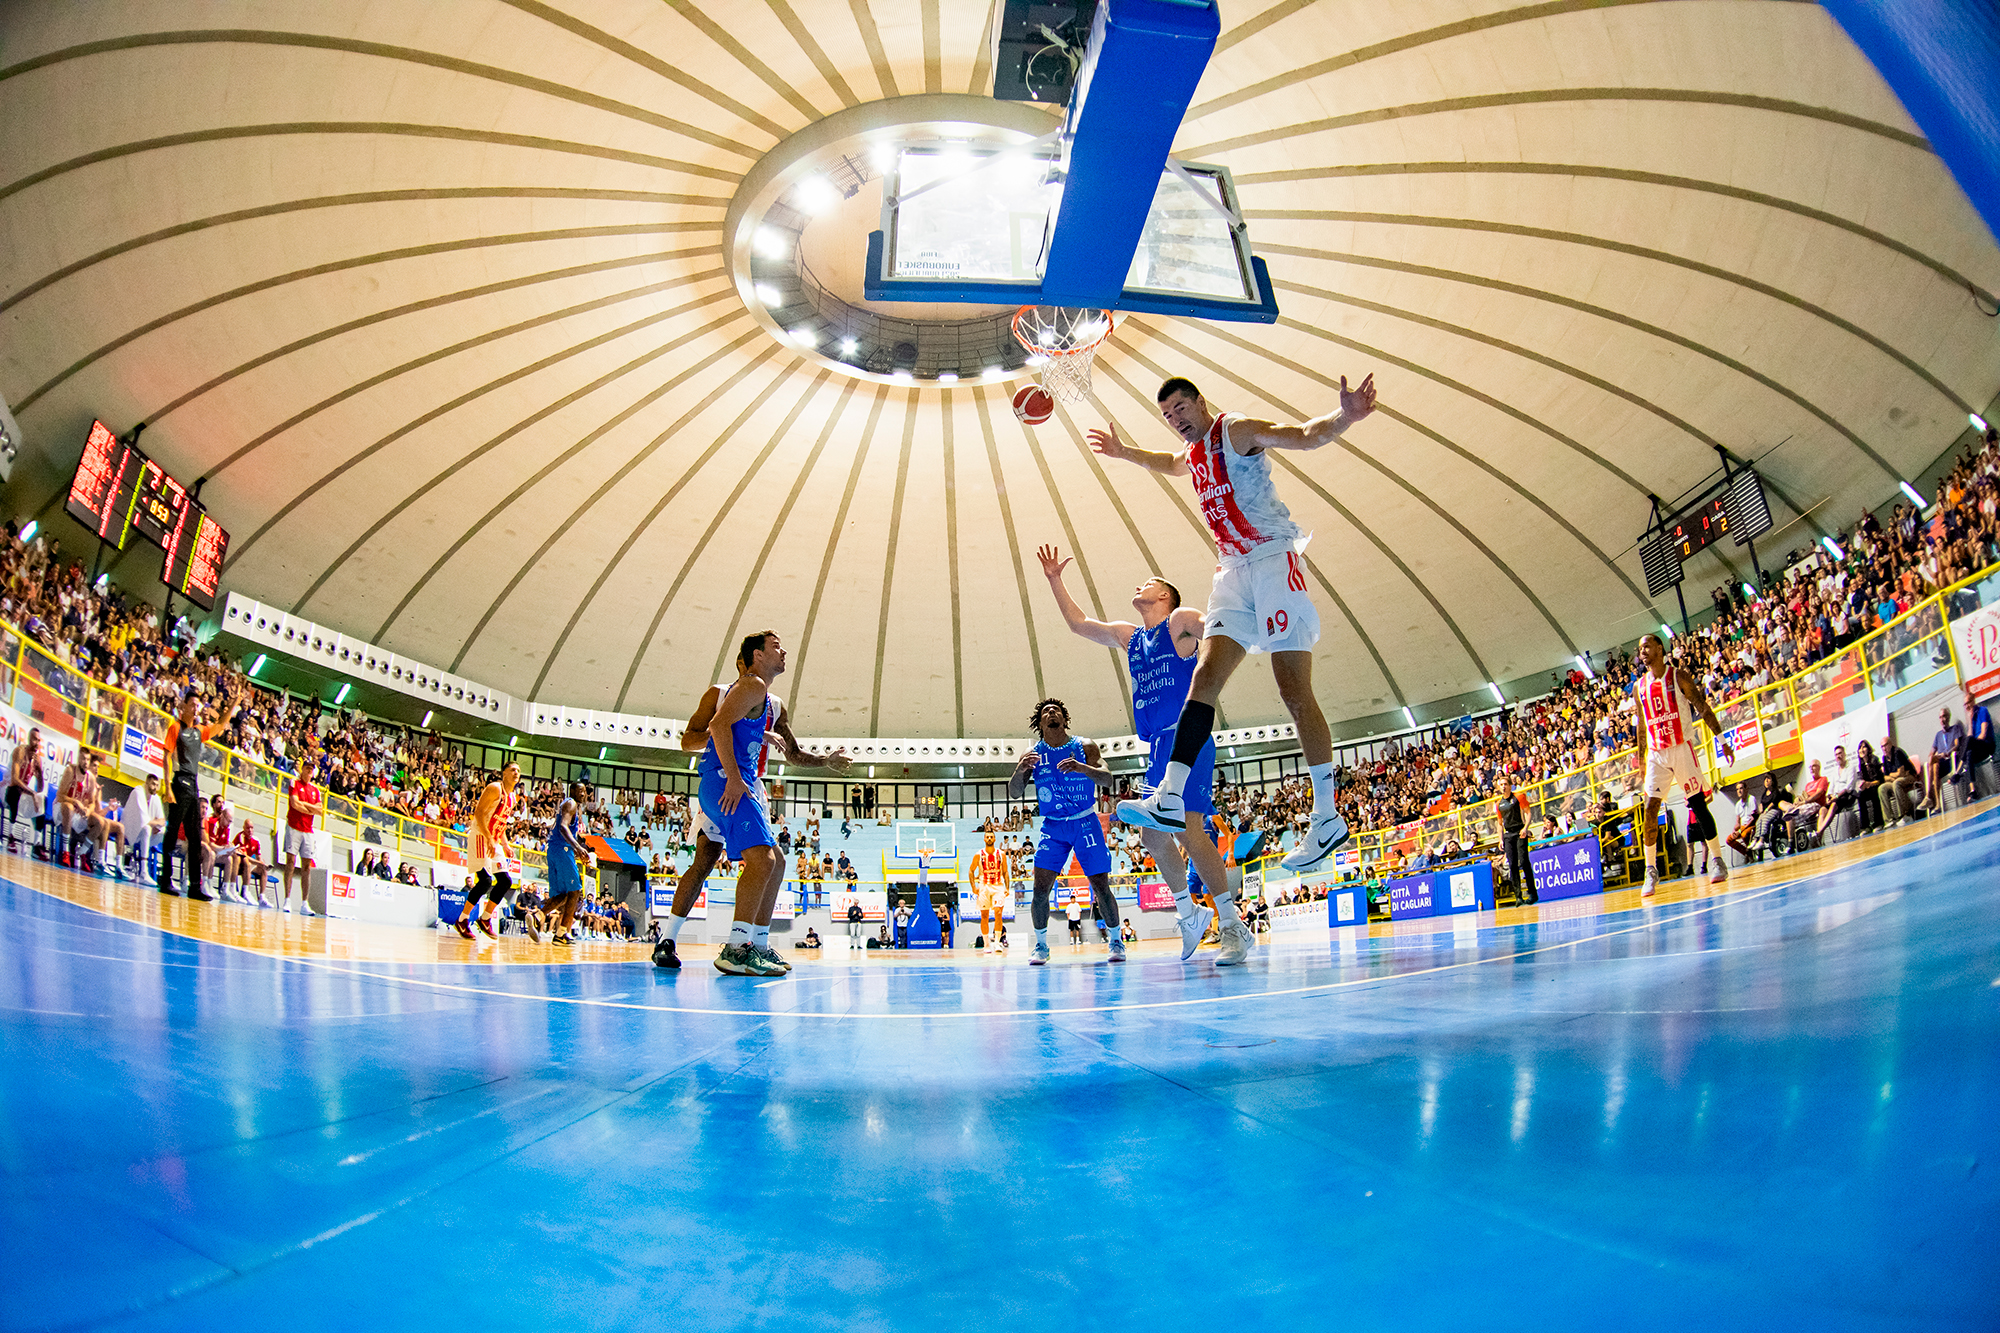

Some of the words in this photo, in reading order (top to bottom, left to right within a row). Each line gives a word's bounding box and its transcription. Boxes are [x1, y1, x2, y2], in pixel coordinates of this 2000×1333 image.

[1711, 511, 1726, 522] CASA
[1720, 517, 1728, 532] 2
[1683, 542, 1690, 555] 0
[1275, 610, 1288, 632] 9
[1648, 712, 1678, 726] meridian
[1038, 753, 1050, 766] 11
[1689, 777, 1699, 792] 13
[1083, 834, 1097, 848] 11
[1533, 855, 1561, 874] CITTÀ
[1534, 877, 1544, 890] DI
[1546, 867, 1594, 888] CAGLIARI
[440, 894, 465, 902] molten
[1391, 885, 1410, 899] CITTÀ
[1392, 901, 1400, 911] DI
[1400, 897, 1432, 910] CAGLIARI
